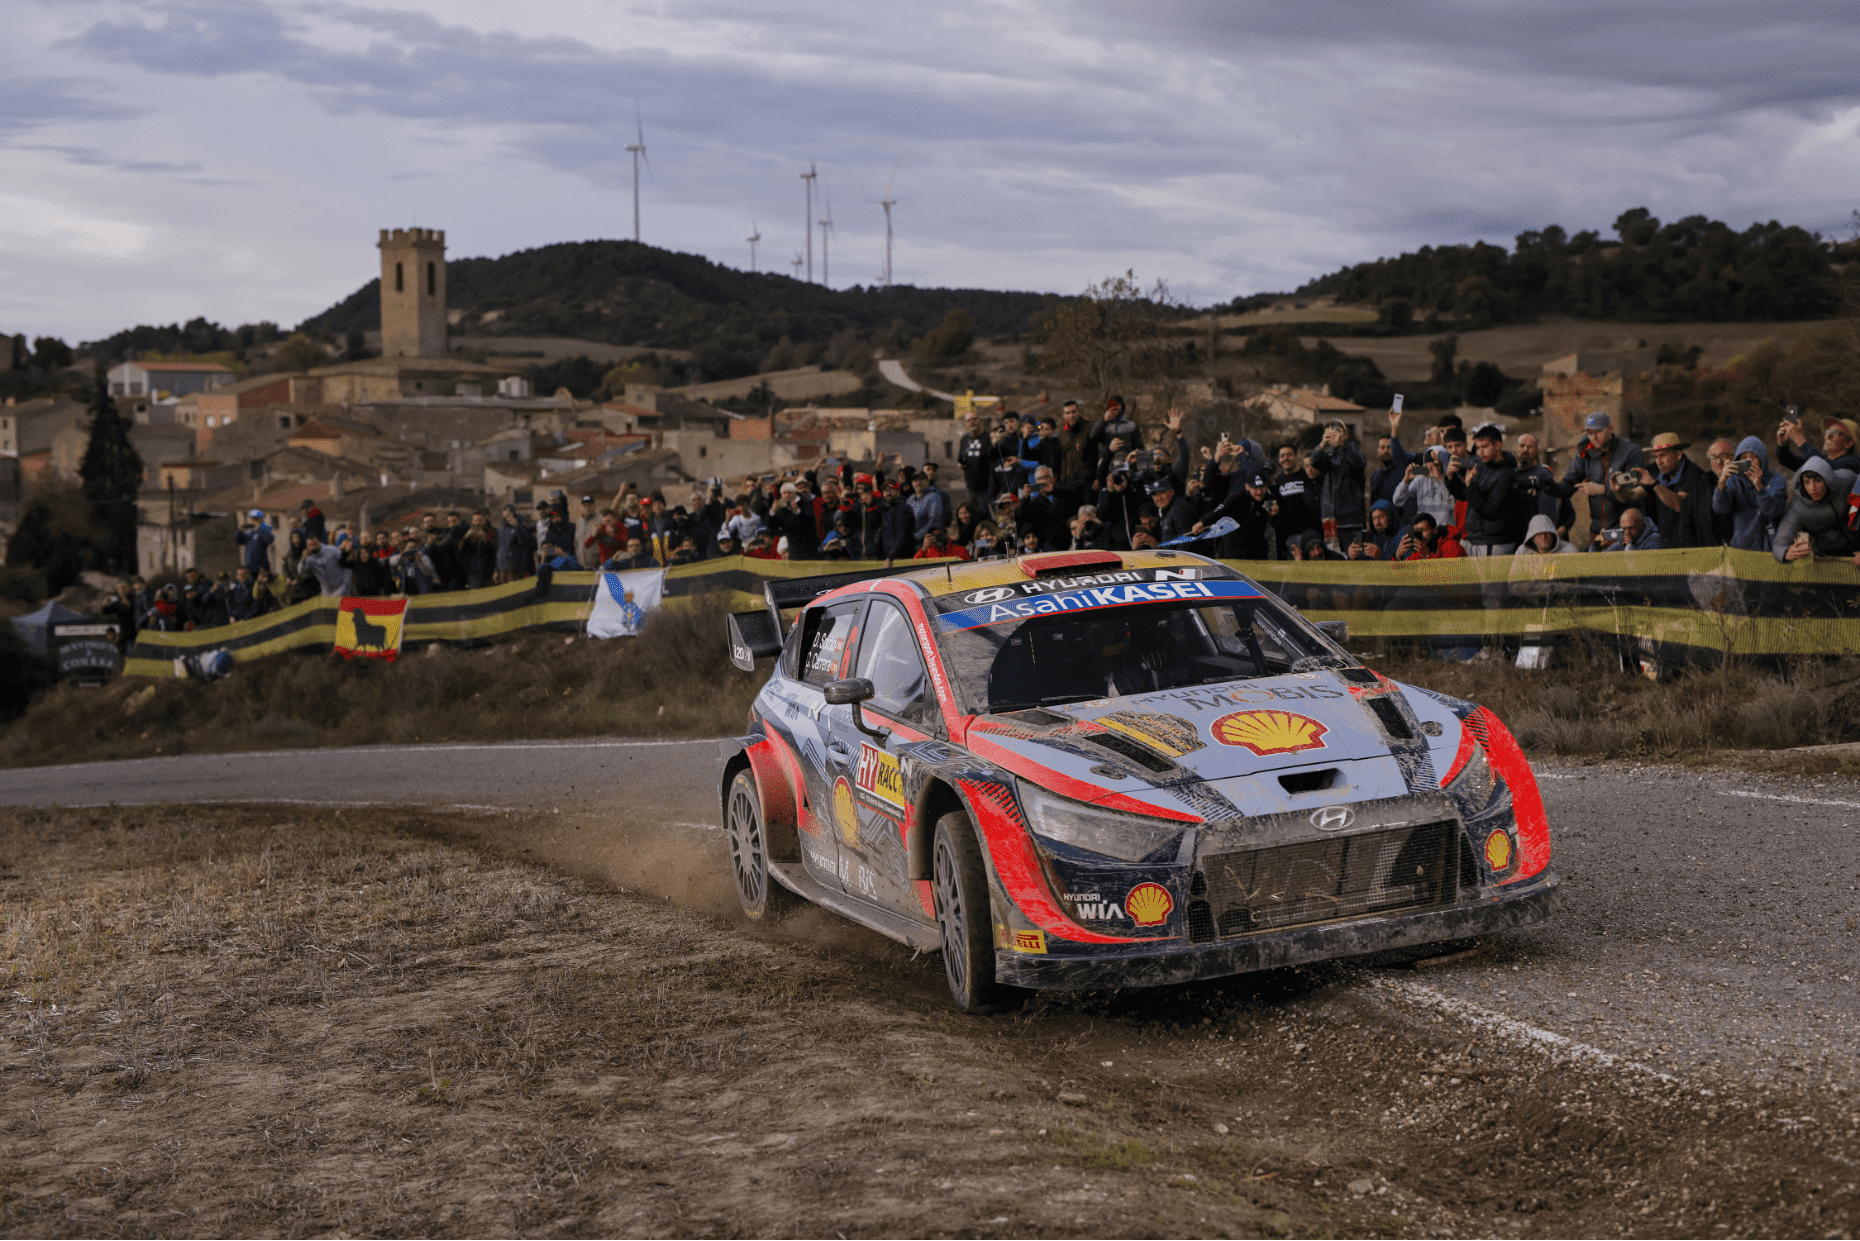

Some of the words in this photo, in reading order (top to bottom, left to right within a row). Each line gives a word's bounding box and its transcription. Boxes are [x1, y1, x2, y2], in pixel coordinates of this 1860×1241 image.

[1021, 571, 1143, 594] HYUNDAI
[1184, 684, 1344, 711] MOBIS
[877, 762, 900, 793] RACC
[1063, 893, 1101, 902] HYUNDAI
